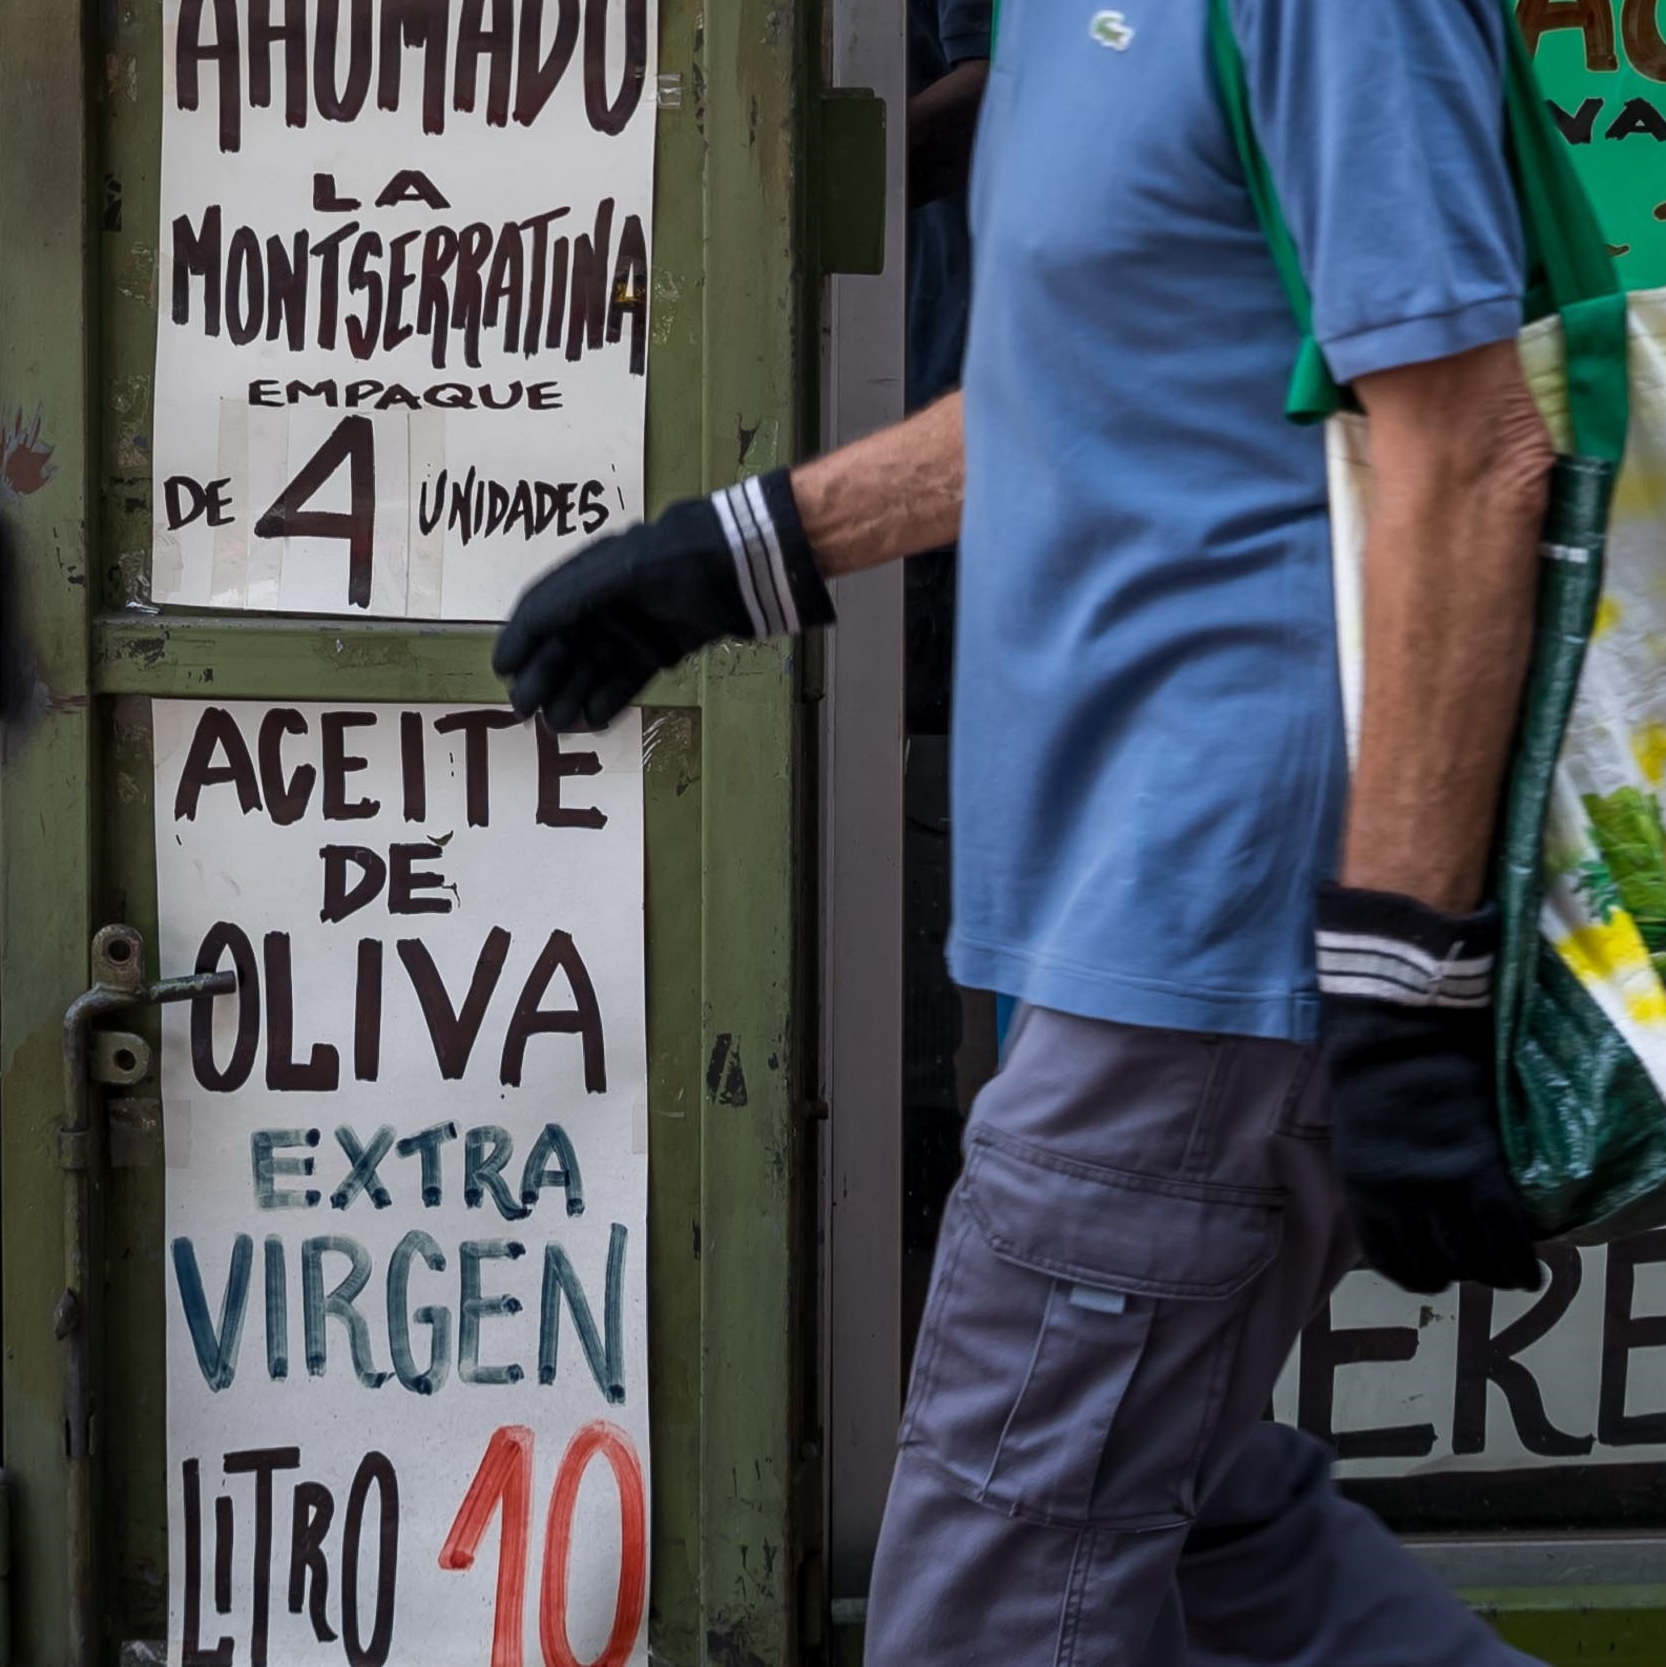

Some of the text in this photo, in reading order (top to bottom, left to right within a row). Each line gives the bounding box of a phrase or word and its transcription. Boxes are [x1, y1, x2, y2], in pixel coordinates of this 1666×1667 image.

[312, 169, 451, 213] LA
[171, 197, 648, 377] MONTSERRATINA
[248, 378, 563, 411] EMPAQUE
[163, 414, 610, 609] DE 4 UNIDADES
[175, 708, 608, 831] ACEITE
[190, 921, 608, 1094] OLIVA
[251, 1121, 585, 1222] EXTRA
[170, 1222, 628, 1405] VIRGEN
[181, 1419, 647, 1667] LITRO 10
